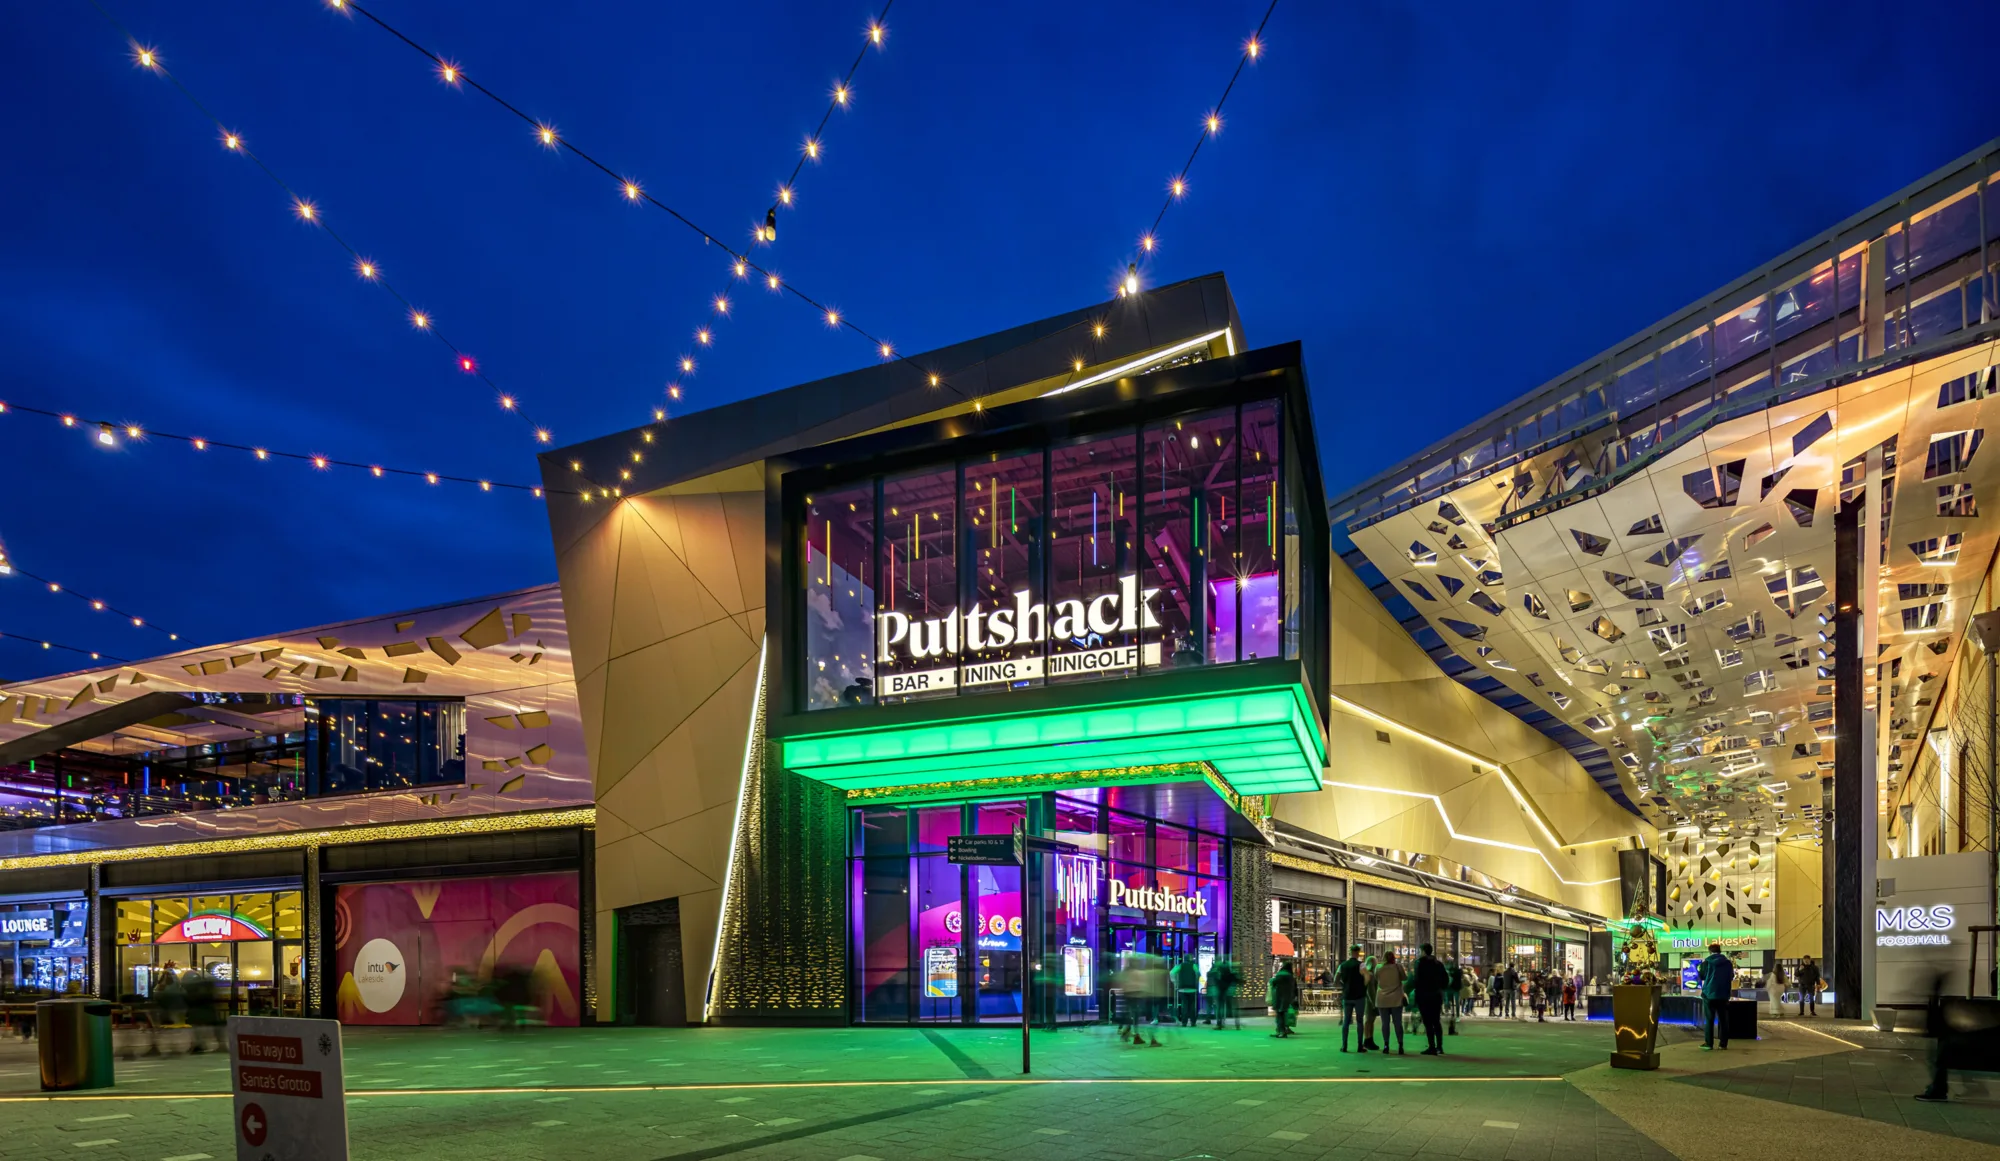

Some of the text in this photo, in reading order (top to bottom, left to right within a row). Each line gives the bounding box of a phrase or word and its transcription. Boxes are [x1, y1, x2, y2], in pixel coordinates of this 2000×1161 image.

[872, 574, 1162, 663] Puttshack
[893, 674, 929, 692] BAR
[1109, 879, 1208, 916] Puttshack
[2, 918, 48, 933] LOUNGE
[1877, 906, 1953, 931] M&S
[1673, 935, 1757, 948] intu Lakeside
[1878, 935, 1950, 946] FOODHALL
[358, 962, 385, 984] intu Lakeside
[240, 1041, 296, 1061] This way to
[242, 1072, 311, 1092] Santa's Grotto
